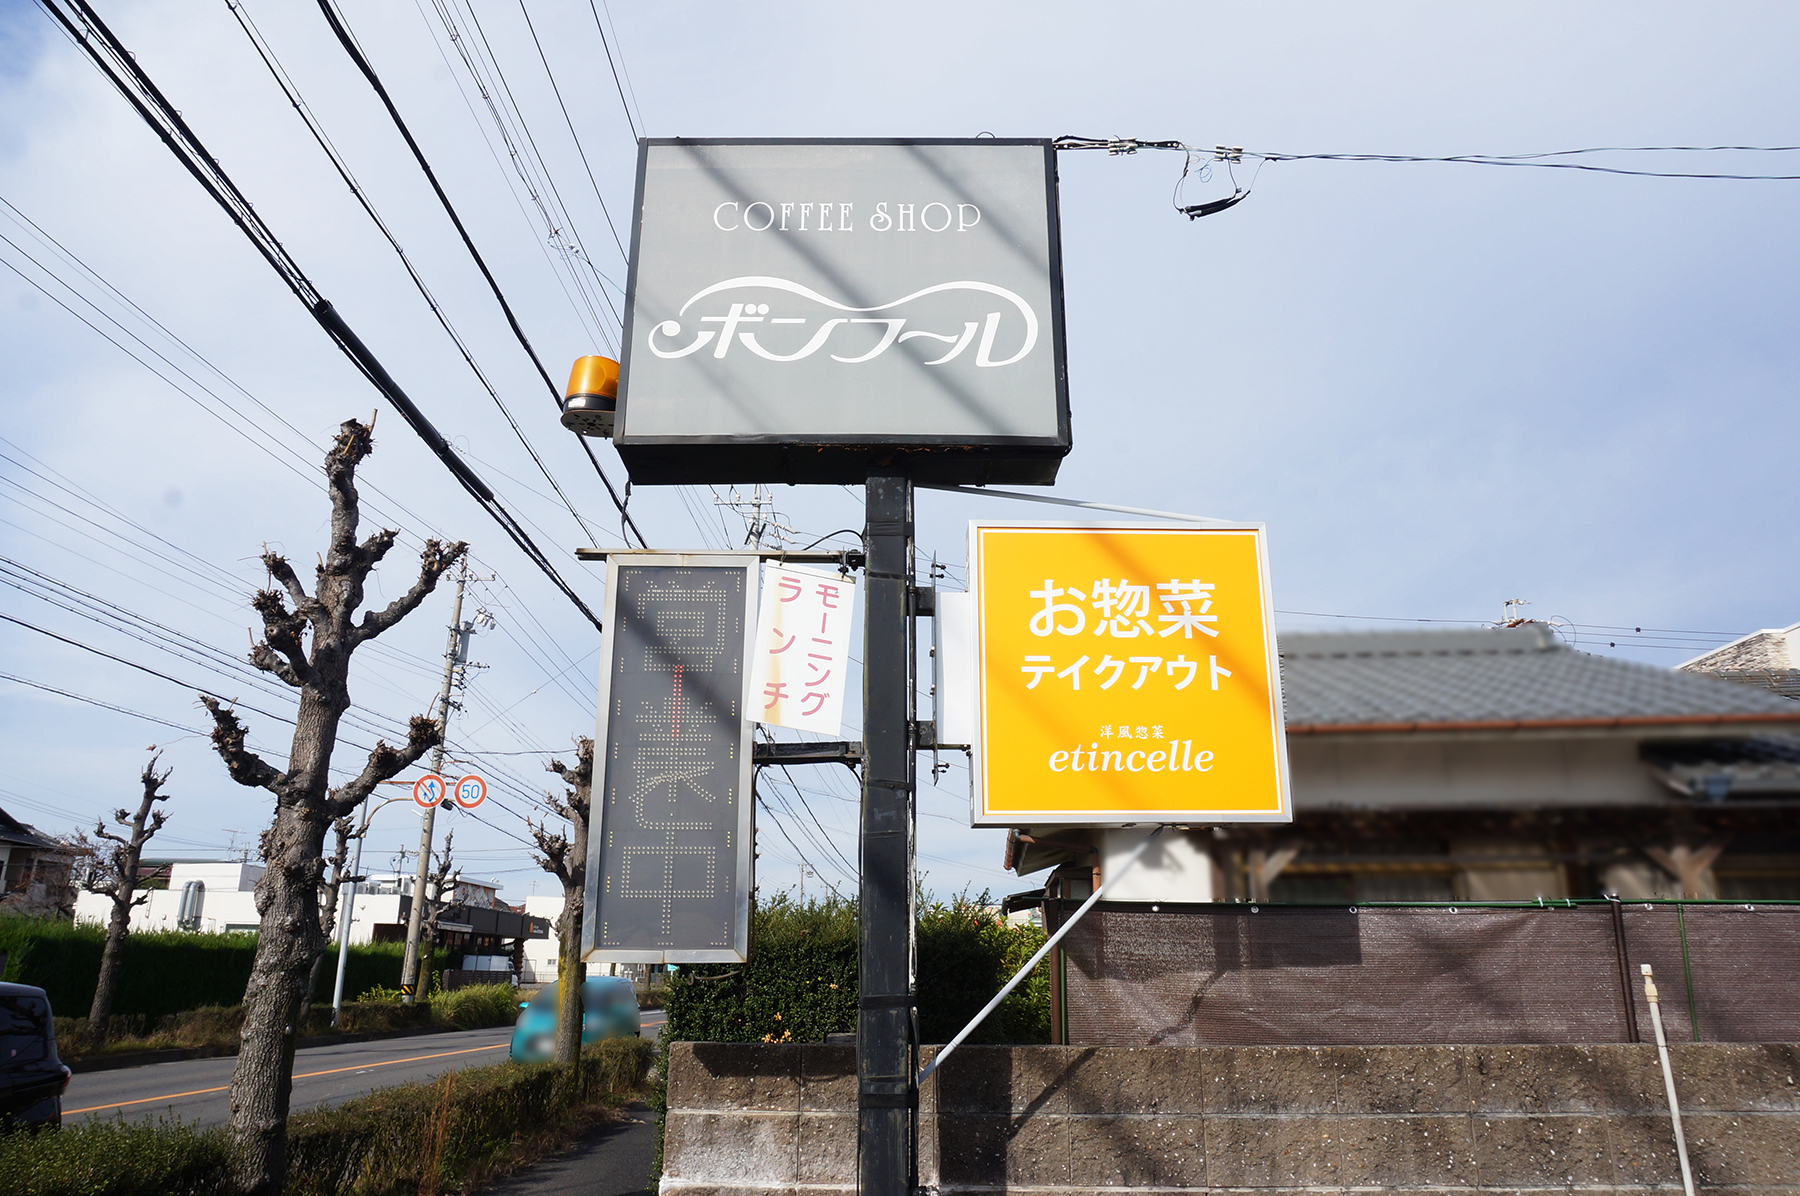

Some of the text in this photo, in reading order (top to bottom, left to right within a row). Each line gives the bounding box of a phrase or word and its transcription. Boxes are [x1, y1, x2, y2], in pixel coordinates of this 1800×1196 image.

[713, 201, 981, 232] COFFEE SHOP
[1029, 578, 1219, 639] お惣菜
[763, 576, 802, 709] ランチ
[800, 583, 840, 716] モーニング
[1021, 654, 1232, 691] テイクアウト
[1099, 724, 1165, 740] 洋風惣菜
[621, 581, 727, 935] 営業中
[1048, 739, 1215, 772] etincelle
[461, 784, 480, 799] 50
